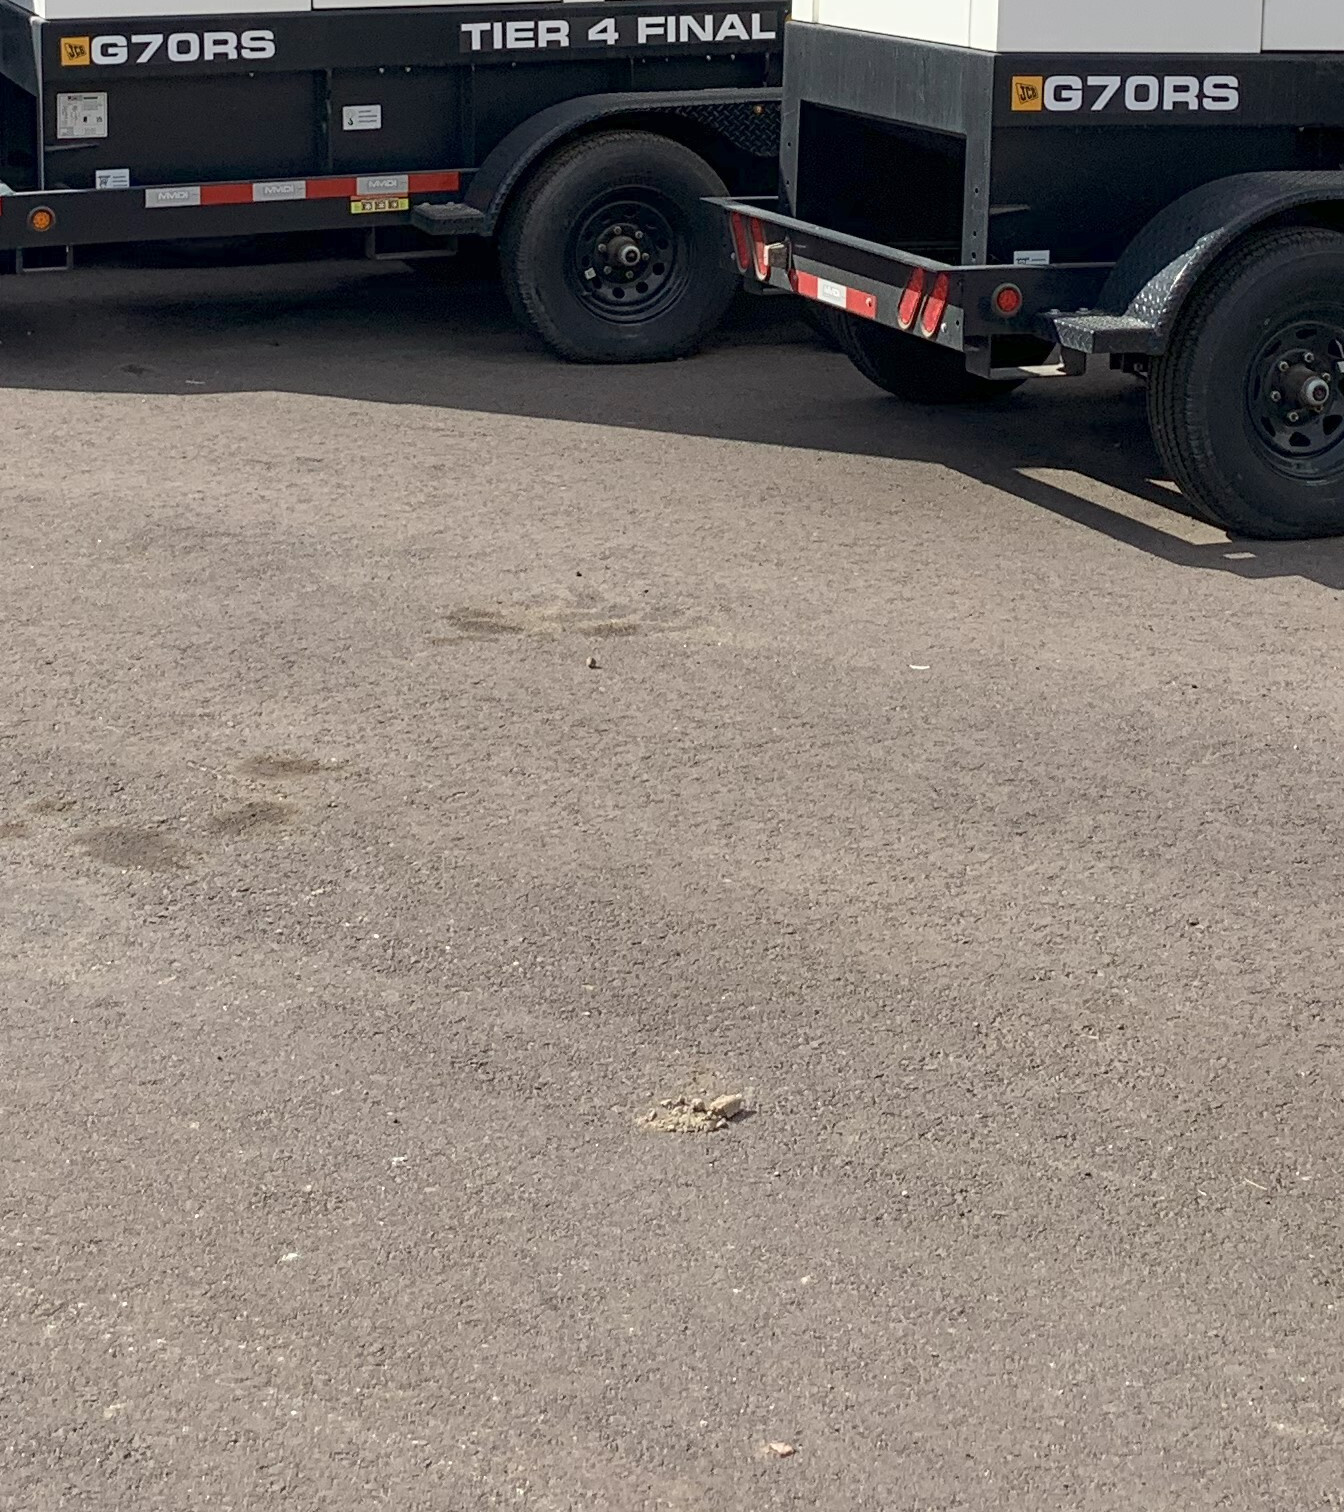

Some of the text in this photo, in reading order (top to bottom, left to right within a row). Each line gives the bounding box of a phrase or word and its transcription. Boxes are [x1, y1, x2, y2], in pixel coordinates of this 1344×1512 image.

[91, 29, 276, 65] G70RS
[461, 13, 776, 50] TIER 4 FINAL
[1043, 75, 1240, 111] G70RS
